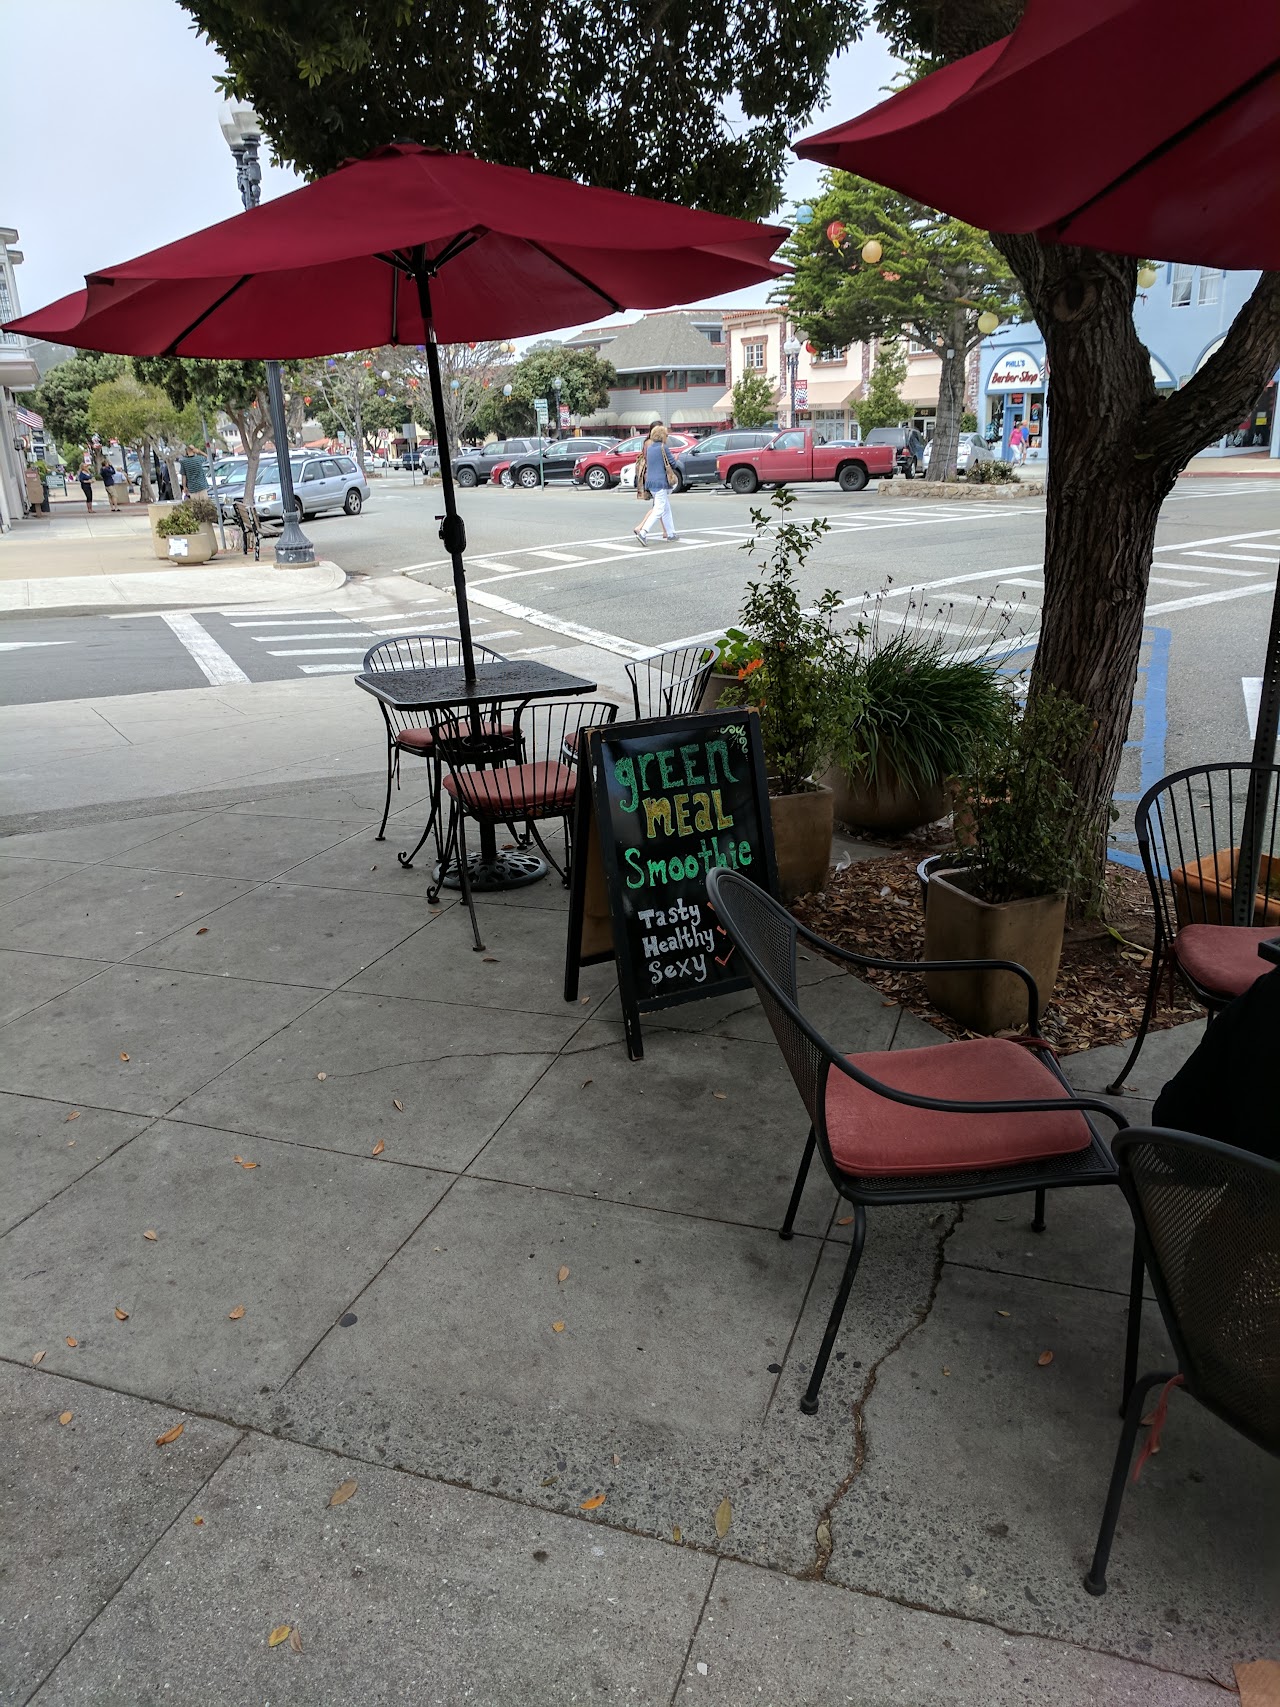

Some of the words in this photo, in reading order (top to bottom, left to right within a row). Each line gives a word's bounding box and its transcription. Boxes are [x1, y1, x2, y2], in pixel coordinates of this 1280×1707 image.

[992, 372, 1019, 383] Barber
[1019, 371, 1038, 385] Shop
[625, 837, 752, 889] Smoothie
[638, 898, 700, 929] Tasty
[642, 926, 715, 957] Healthy
[649, 954, 707, 984] Sexy
